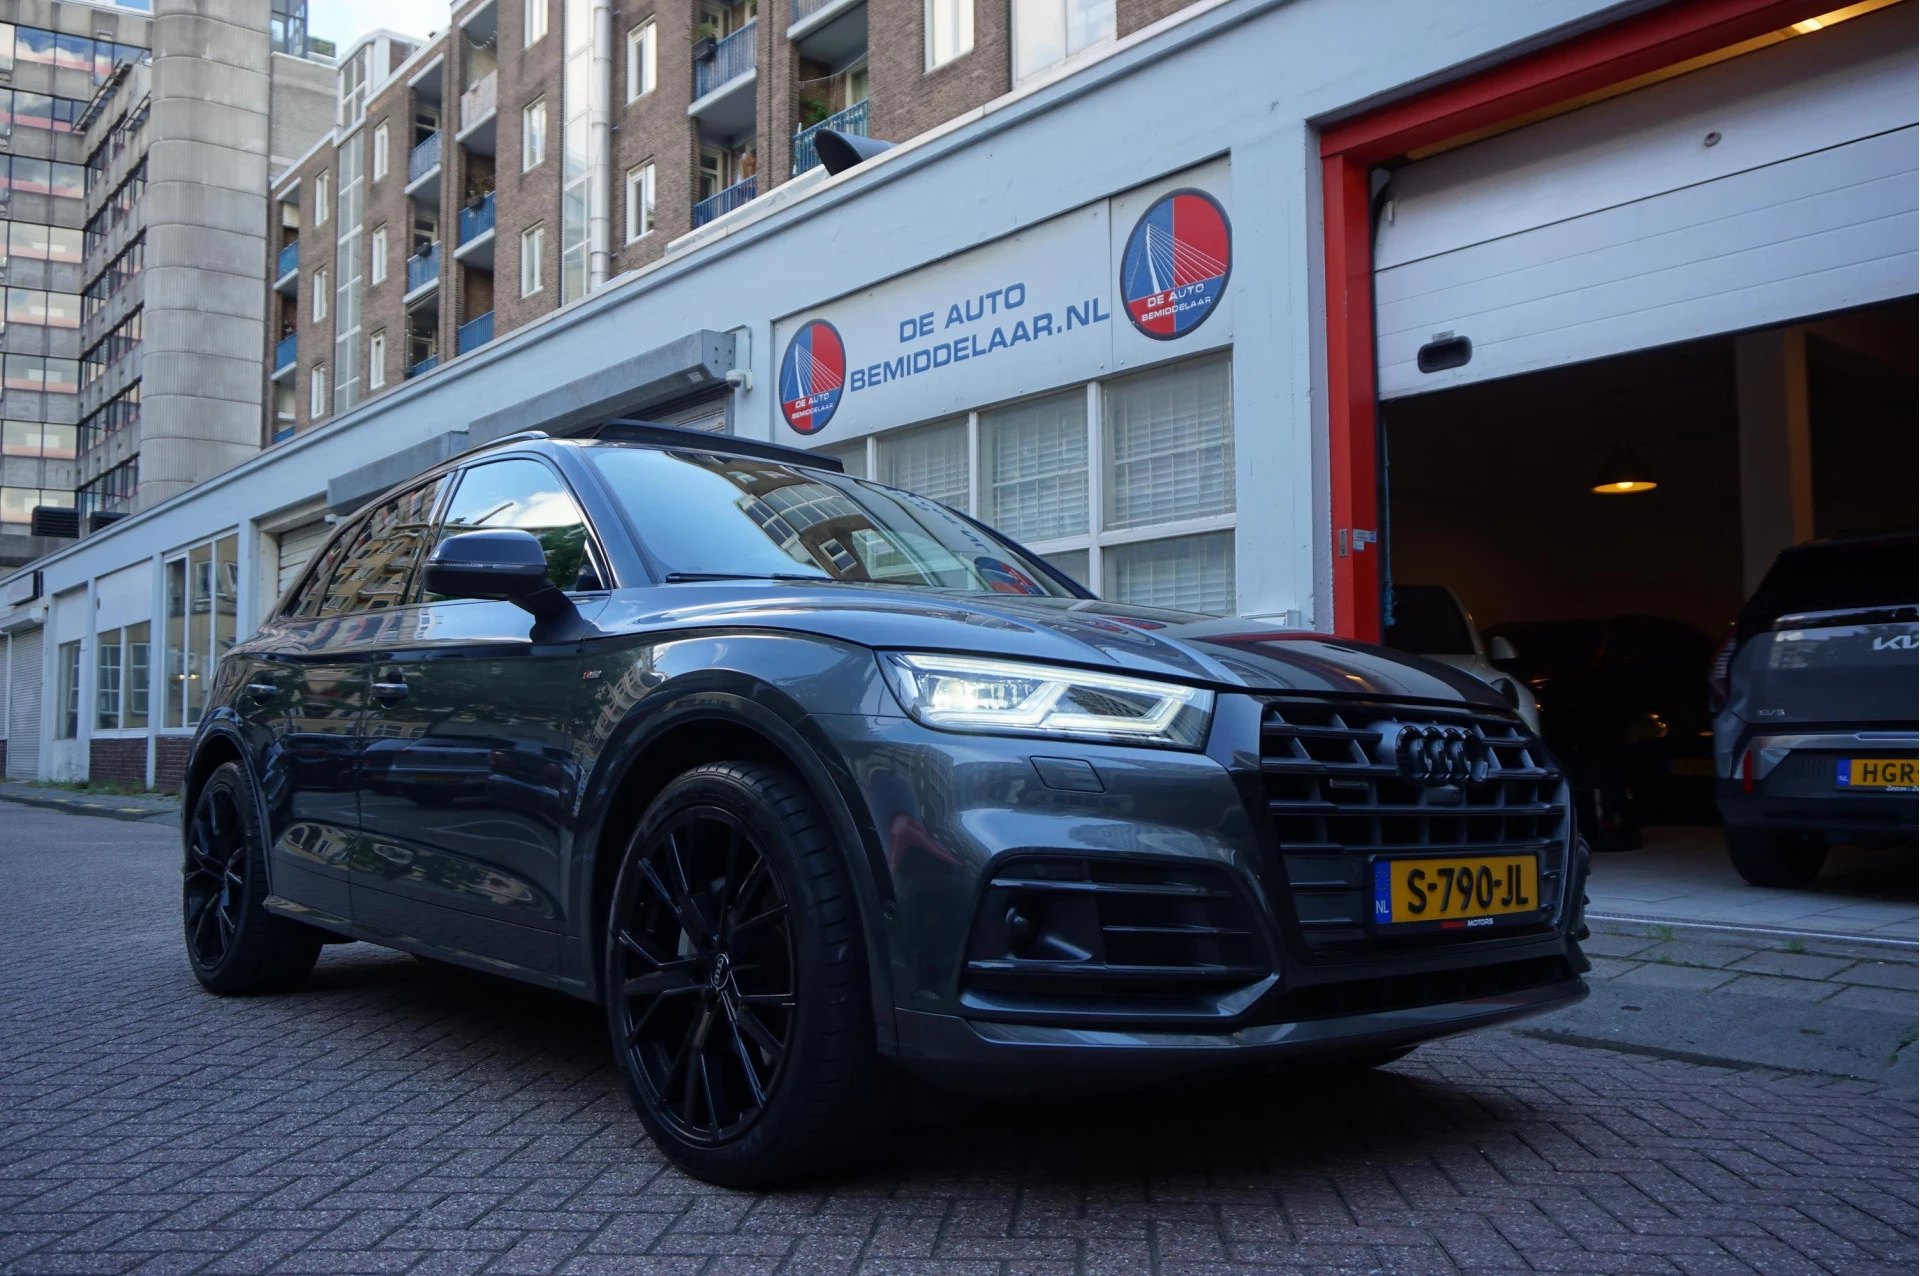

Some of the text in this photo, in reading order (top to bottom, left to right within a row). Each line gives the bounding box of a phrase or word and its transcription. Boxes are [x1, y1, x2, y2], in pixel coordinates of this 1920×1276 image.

[1147, 283, 1205, 308] DE AUTO
[899, 282, 1026, 343] DE AUTO
[1141, 296, 1212, 322] BEMIDDELAAR
[850, 297, 1110, 392] BEMIDDELAAR.NL
[795, 392, 830, 409] DE AUTO
[1407, 864, 1529, 914] S-790-JL
[1376, 900, 1389, 914] NL
[1467, 918, 1494, 927] MOTORS
